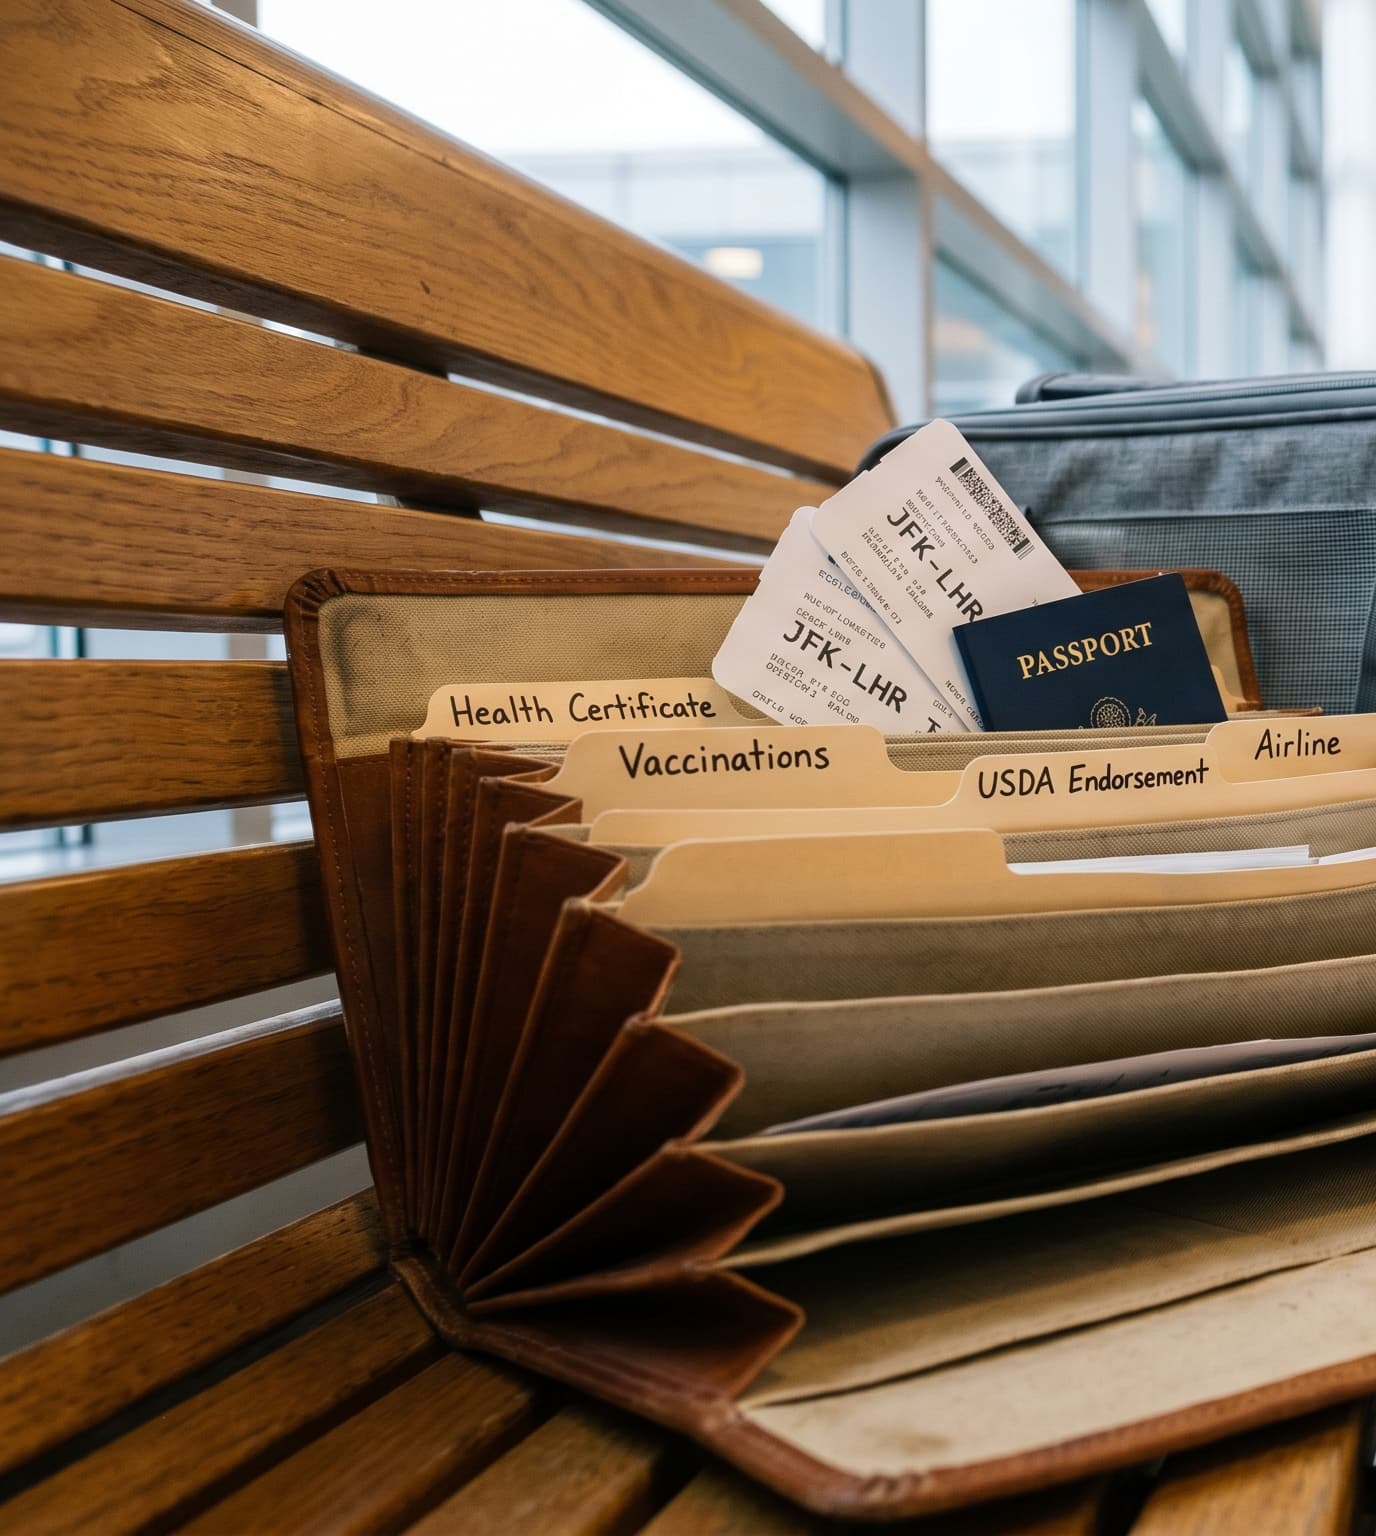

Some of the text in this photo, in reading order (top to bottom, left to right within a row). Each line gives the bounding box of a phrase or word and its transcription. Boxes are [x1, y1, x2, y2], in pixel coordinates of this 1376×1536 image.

[886, 506, 984, 622] JFK-LHR
[783, 621, 907, 713] JFK-LHR
[1017, 621, 1152, 679] PASSPORT
[450, 695, 554, 727] Health
[568, 691, 717, 722] Certificate
[618, 741, 830, 779] Vaccinations
[1254, 728, 1342, 761] Airline
[978, 757, 1210, 799] USDA Endorsement
